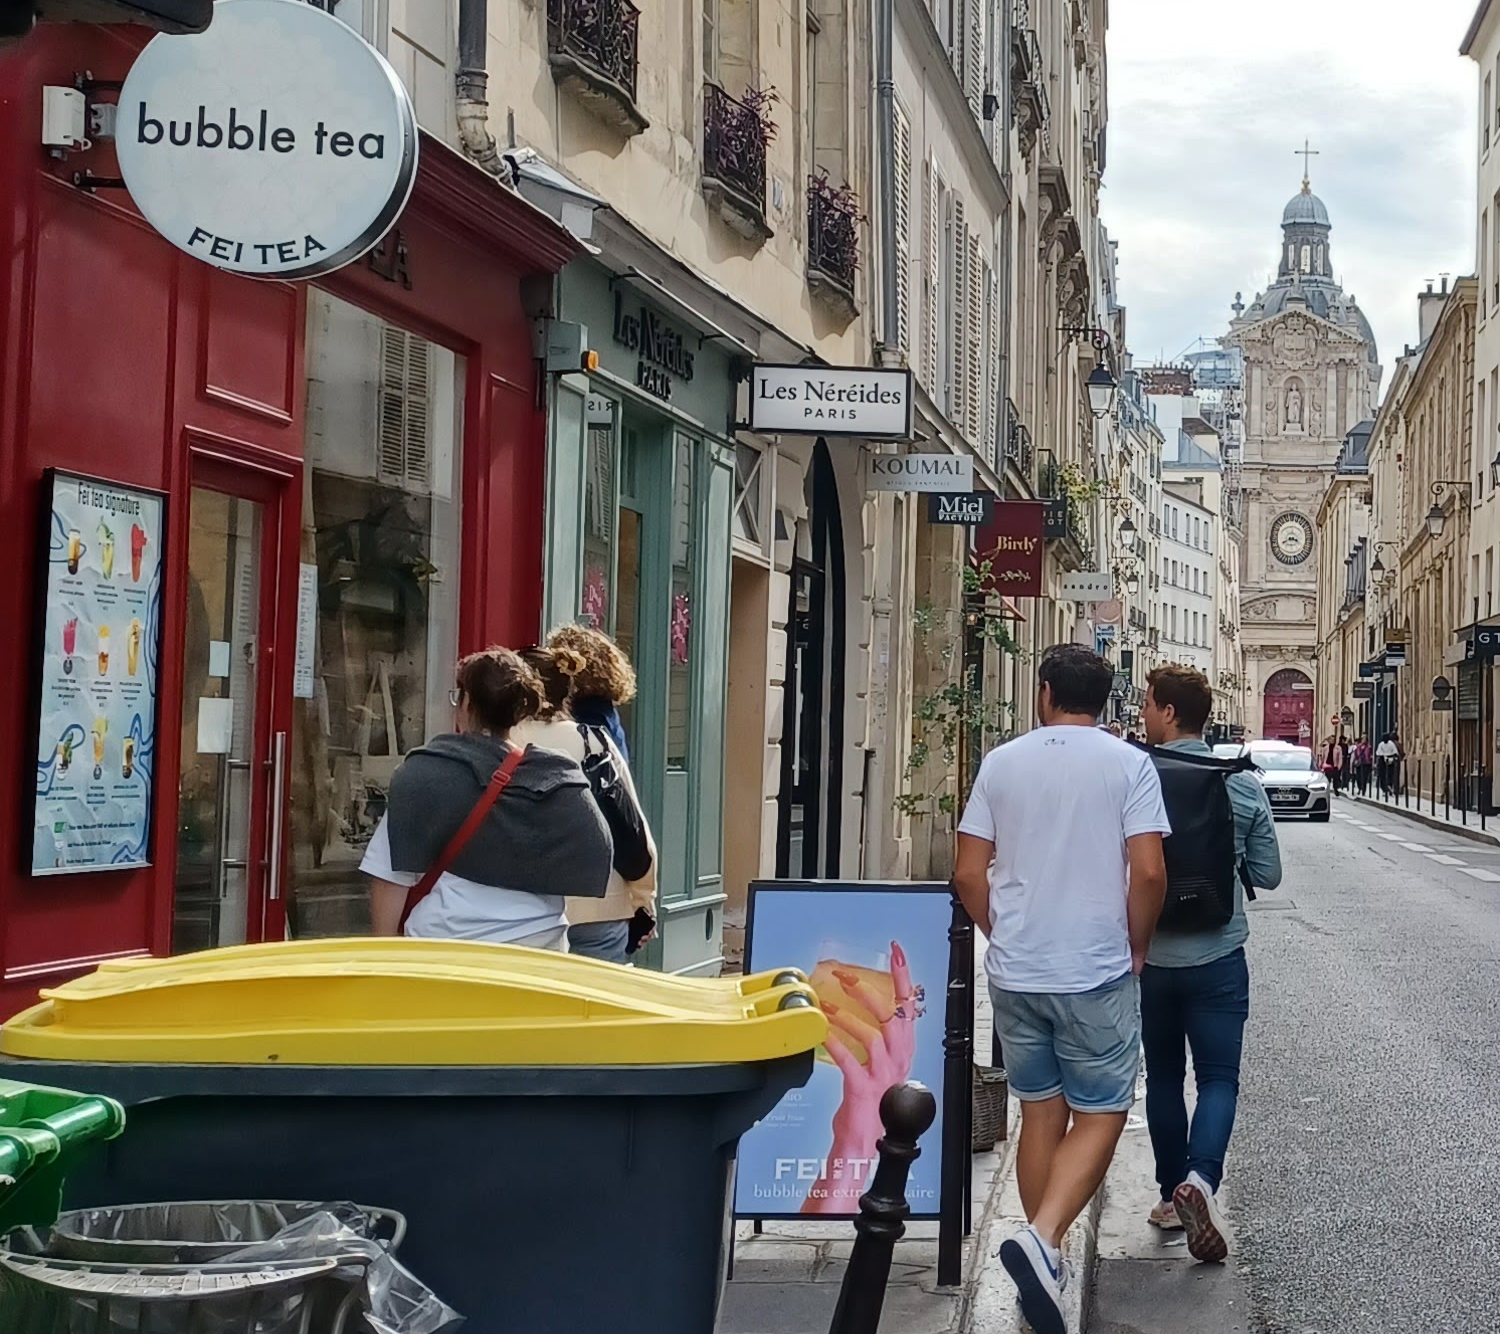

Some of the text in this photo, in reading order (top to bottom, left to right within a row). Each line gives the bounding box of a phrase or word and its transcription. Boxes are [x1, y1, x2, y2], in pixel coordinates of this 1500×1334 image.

[137, 101, 385, 159] bubble tea
[187, 226, 327, 265] FEI TEA
[613, 288, 640, 351] Les
[758, 378, 901, 405] Les Néréides
[804, 407, 857, 420] PARIS
[872, 458, 965, 476] KOUMAL
[938, 495, 983, 514] Miel
[938, 511, 984, 522] FACTORY
[997, 535, 1038, 555] Birdy
[1063, 582, 1109, 591] sandro
[775, 1158, 826, 1180] FEI
[754, 1183, 803, 1199] bubble
[807, 1186, 829, 1199] tea
